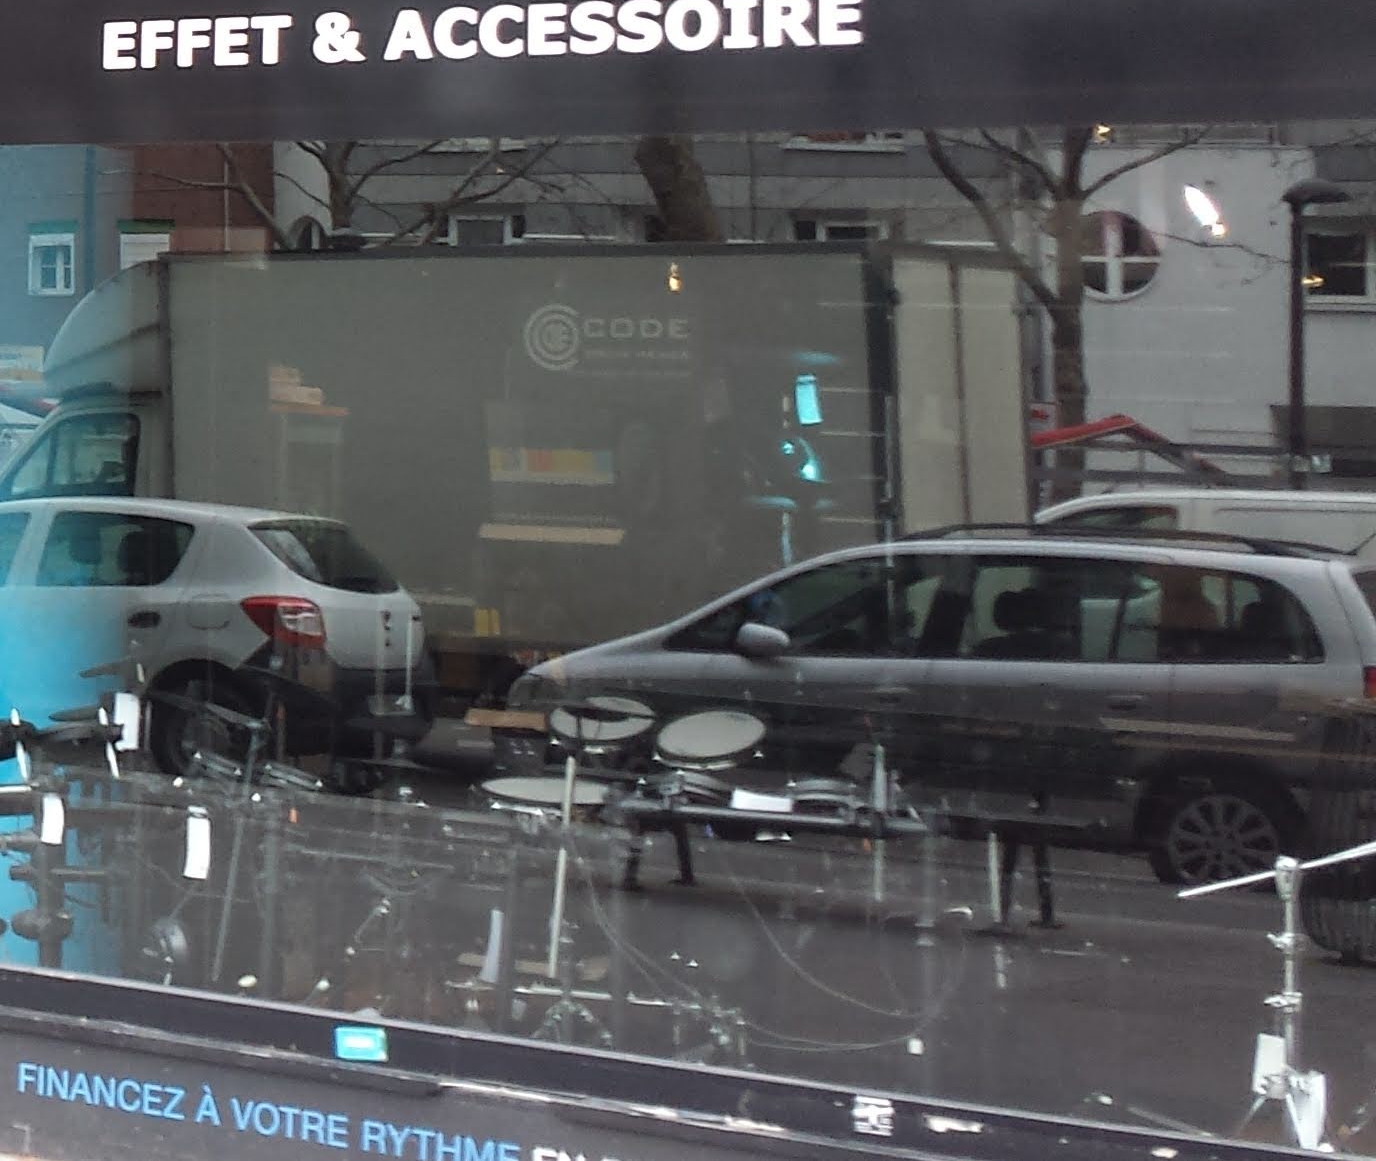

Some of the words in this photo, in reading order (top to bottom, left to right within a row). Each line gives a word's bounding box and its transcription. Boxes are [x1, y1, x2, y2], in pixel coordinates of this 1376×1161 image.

[102, 13, 293, 70] EFFET
[312, 10, 367, 65] &
[16, 1061, 185, 1122] FINANCEZ
[194, 1084, 221, 1126] À
[228, 1098, 349, 1149] VOTRE
[360, 1117, 523, 1161] RYTHME
